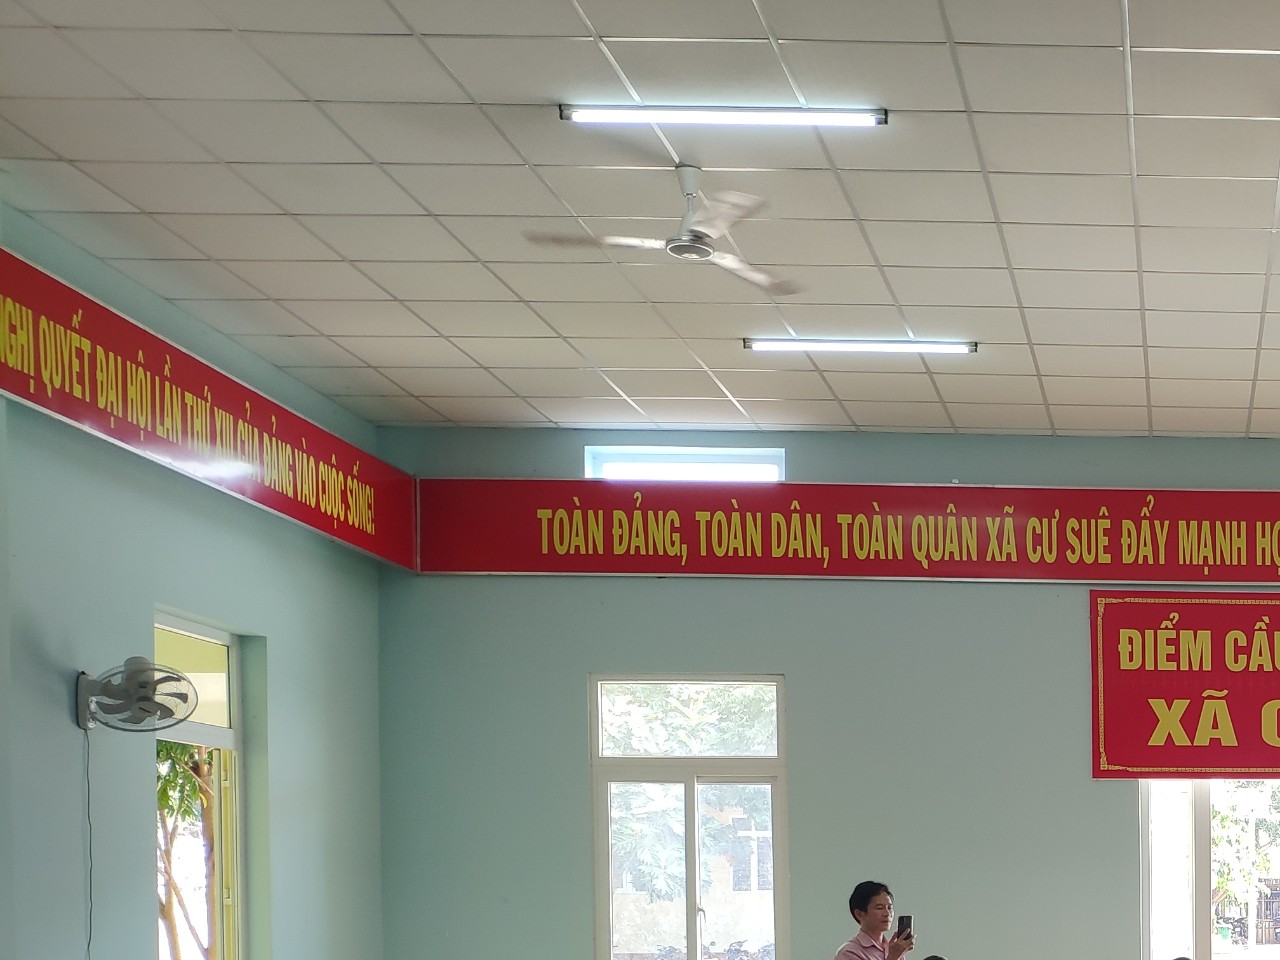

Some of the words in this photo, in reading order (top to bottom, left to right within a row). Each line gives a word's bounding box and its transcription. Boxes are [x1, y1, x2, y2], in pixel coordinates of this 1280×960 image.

[39, 309, 91, 402] QUYẾT
[96, 345, 123, 429] ĐẠI
[127, 349, 152, 442] HỘI
[155, 354, 182, 446] LẦN
[185, 385, 212, 460] THỨ
[237, 400, 261, 483] CỦA
[263, 415, 294, 499] ĐẢNG
[294, 437, 317, 509] VÀO
[318, 454, 346, 529] CUỘC
[347, 460, 375, 536] SỐNG!
[537, 497, 603, 556] TOÀN
[612, 492, 688, 566] ĐẢNG,
[695, 499, 762, 558] TOÀN
[771, 500, 830, 568] DÂN,
[837, 502, 903, 560] TOÀN
[911, 504, 978, 569] QUÂN
[986, 505, 1017, 561] XÃ
[1026, 508, 1059, 563] CƯ
[1066, 506, 1111, 564] SUÊ
[1121, 495, 1170, 565] ĐẨY
[1179, 520, 1247, 575] MẠNH
[1118, 612, 1211, 672] ĐIỂM
[1147, 689, 1238, 747] XÃ
